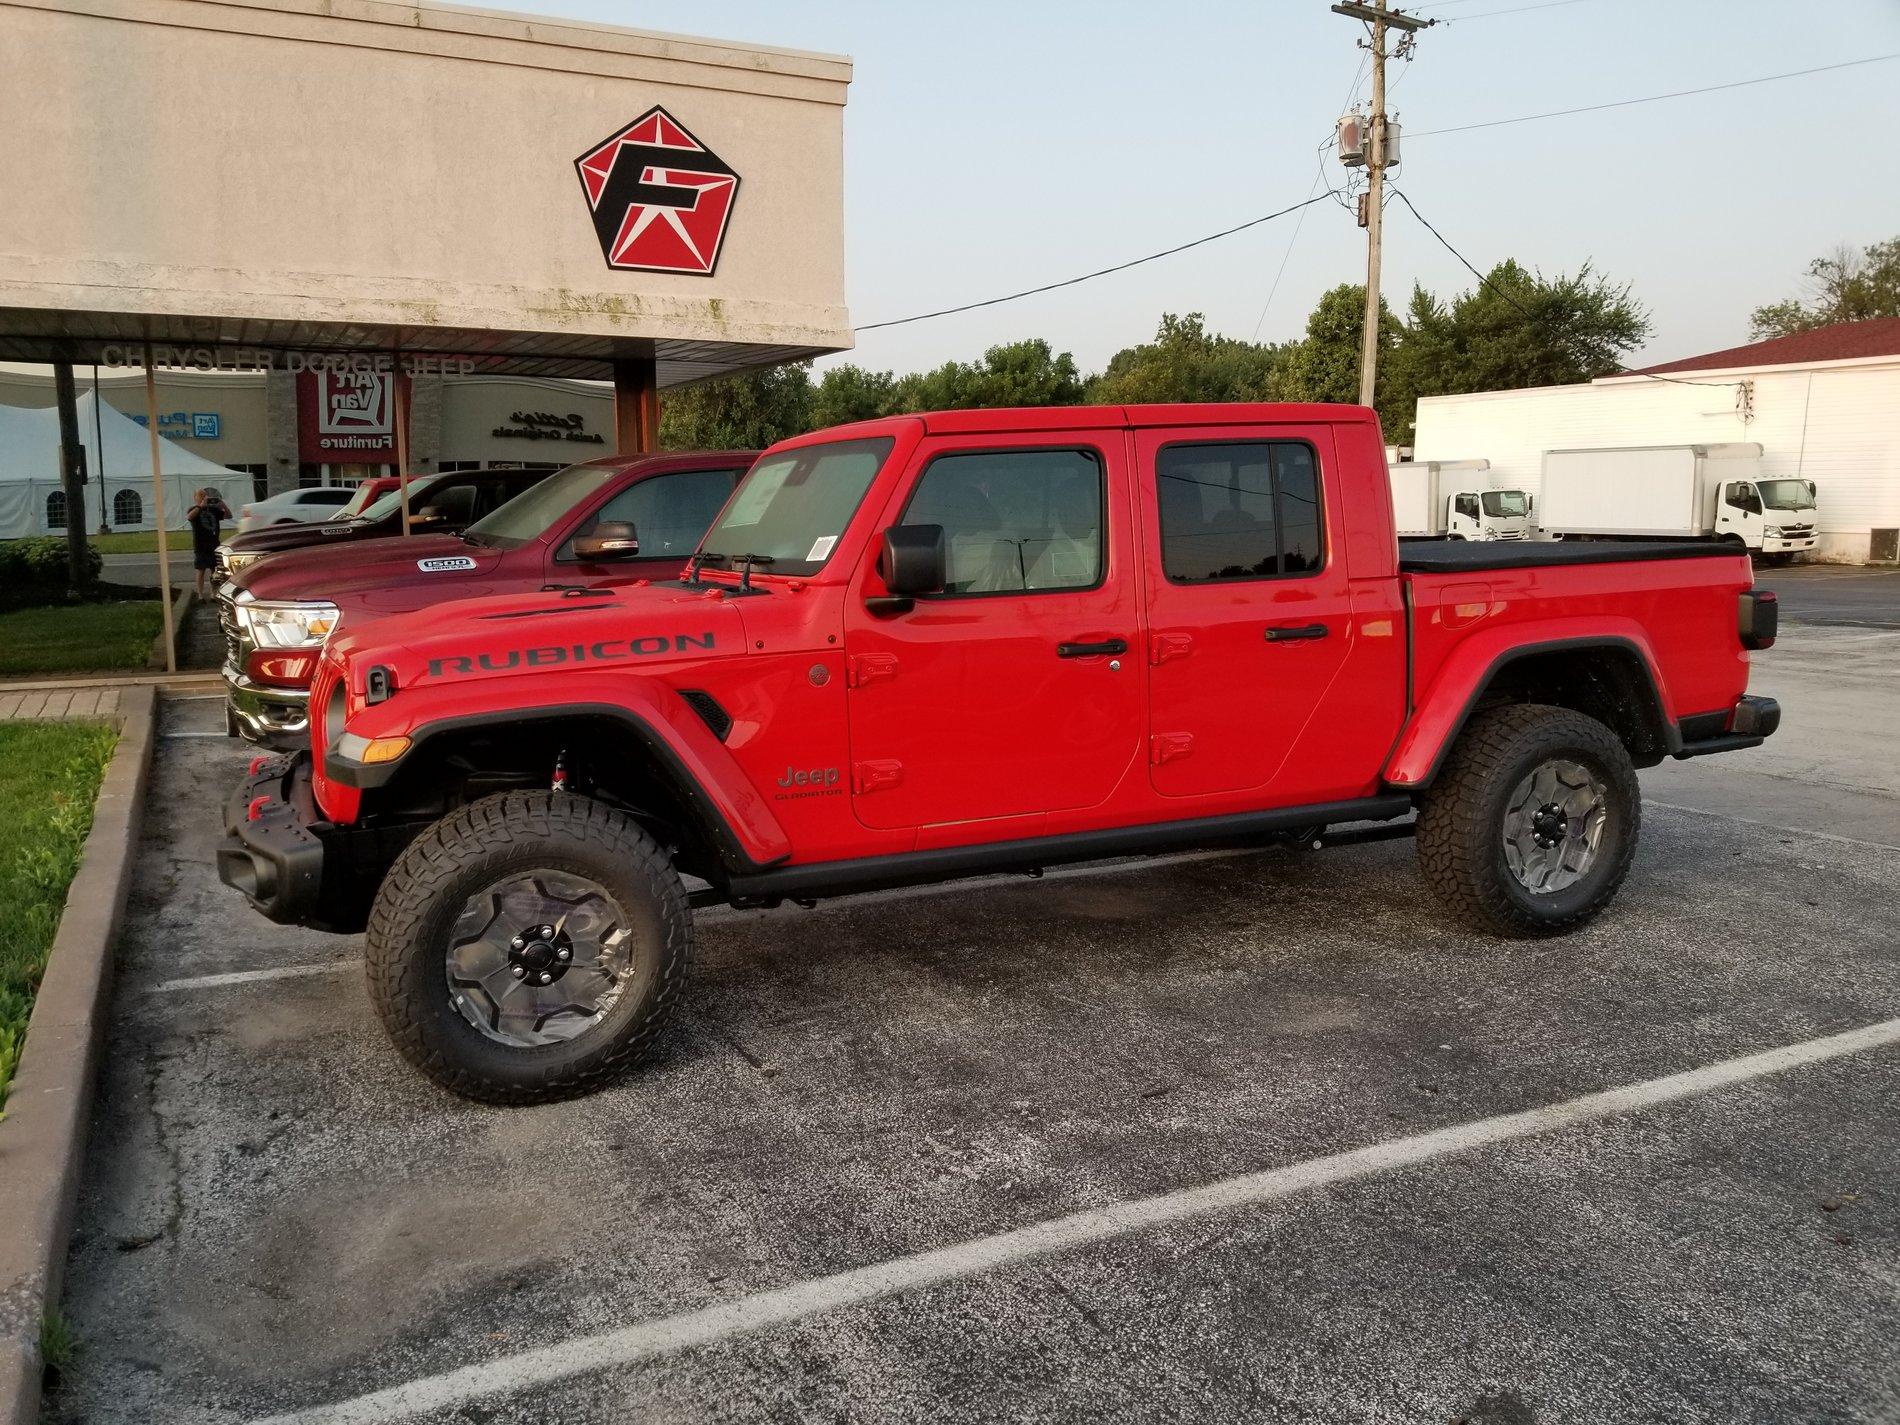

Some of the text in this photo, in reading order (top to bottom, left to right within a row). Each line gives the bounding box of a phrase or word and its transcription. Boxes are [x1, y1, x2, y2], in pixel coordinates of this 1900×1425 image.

[102, 345, 475, 380] CHRYSLER DODGE JEEP
[427, 559, 467, 567] 1500
[428, 632, 715, 676] RUBICON
[777, 766, 839, 788] Jeep
[774, 788, 842, 801] GLADIATOR
